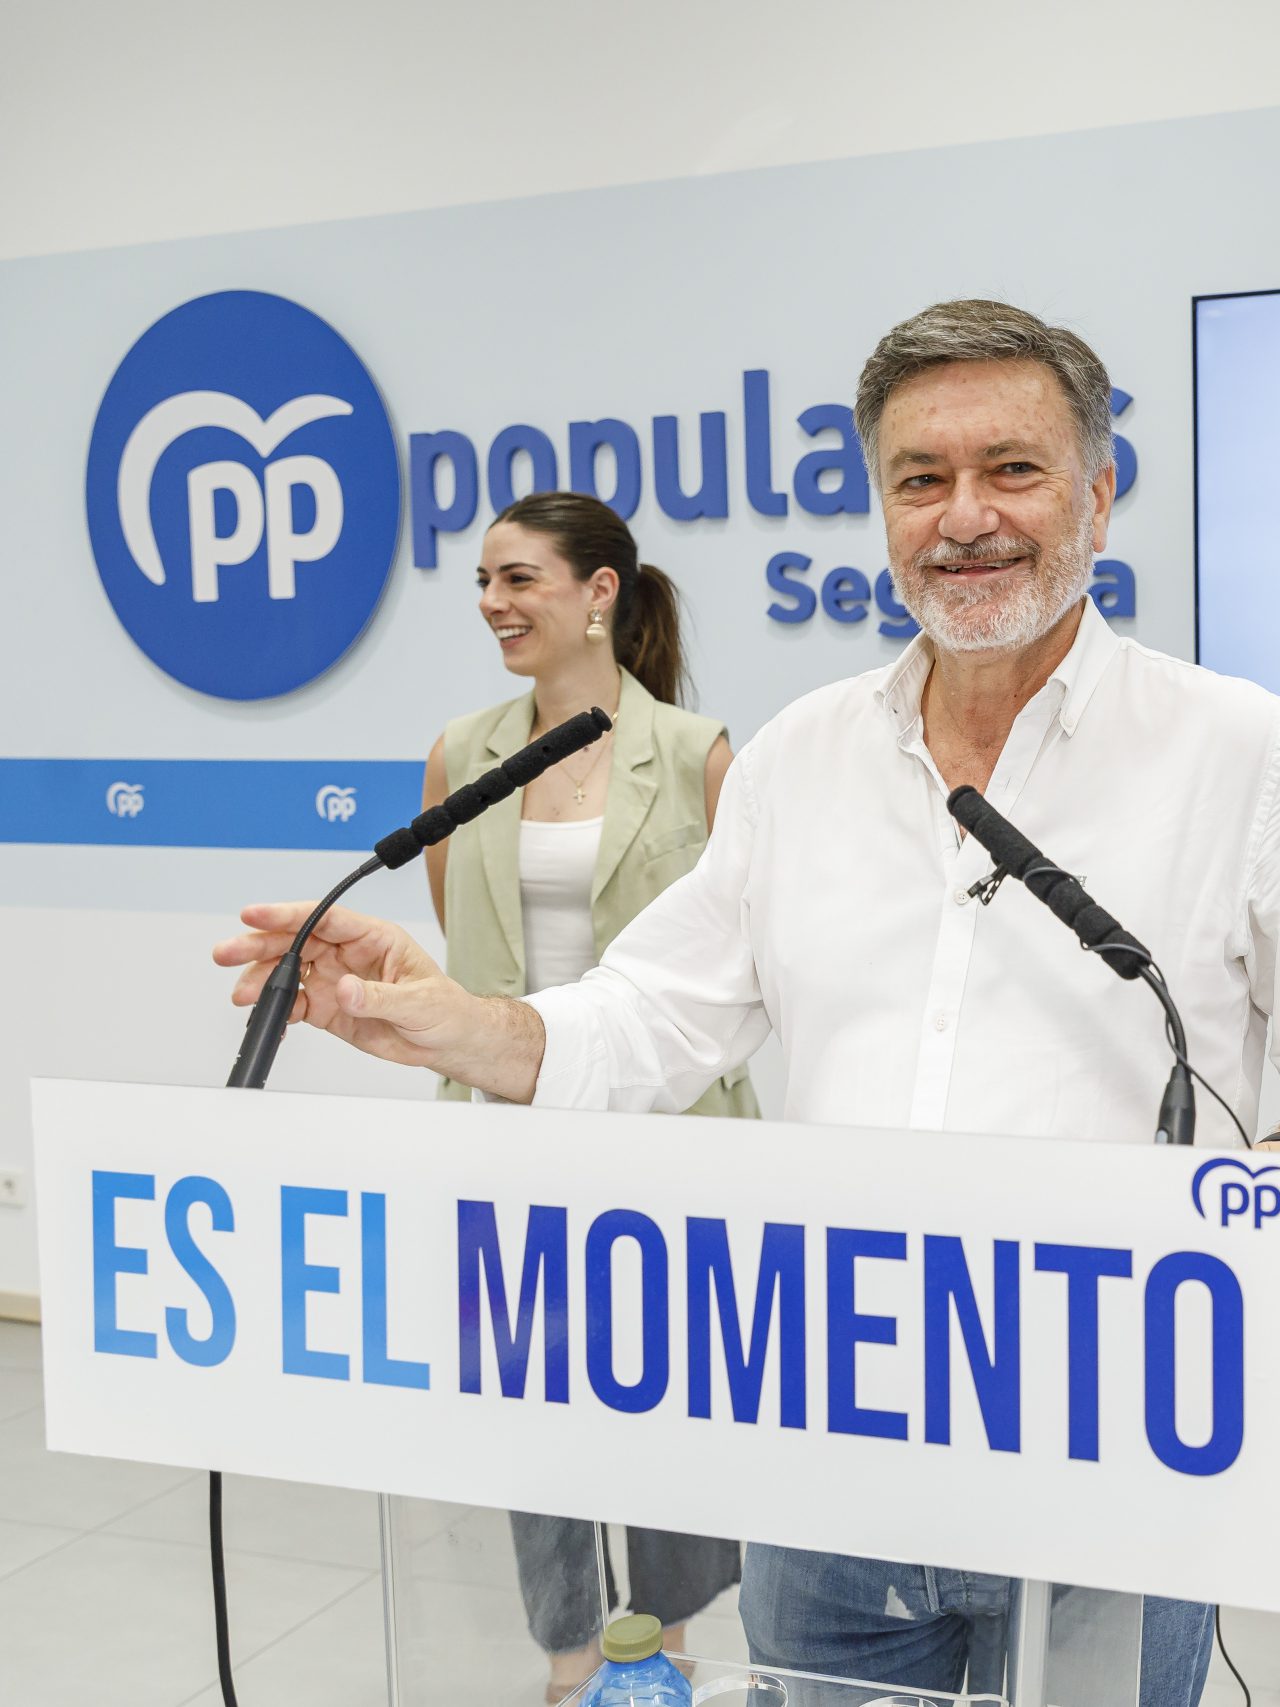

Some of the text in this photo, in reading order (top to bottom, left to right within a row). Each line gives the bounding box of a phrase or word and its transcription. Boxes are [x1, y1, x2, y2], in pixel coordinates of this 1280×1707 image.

[187, 454, 344, 602] pp
[409, 369, 1137, 568] popula
[91, 1169, 1245, 1477] ES EL MOMENTO
